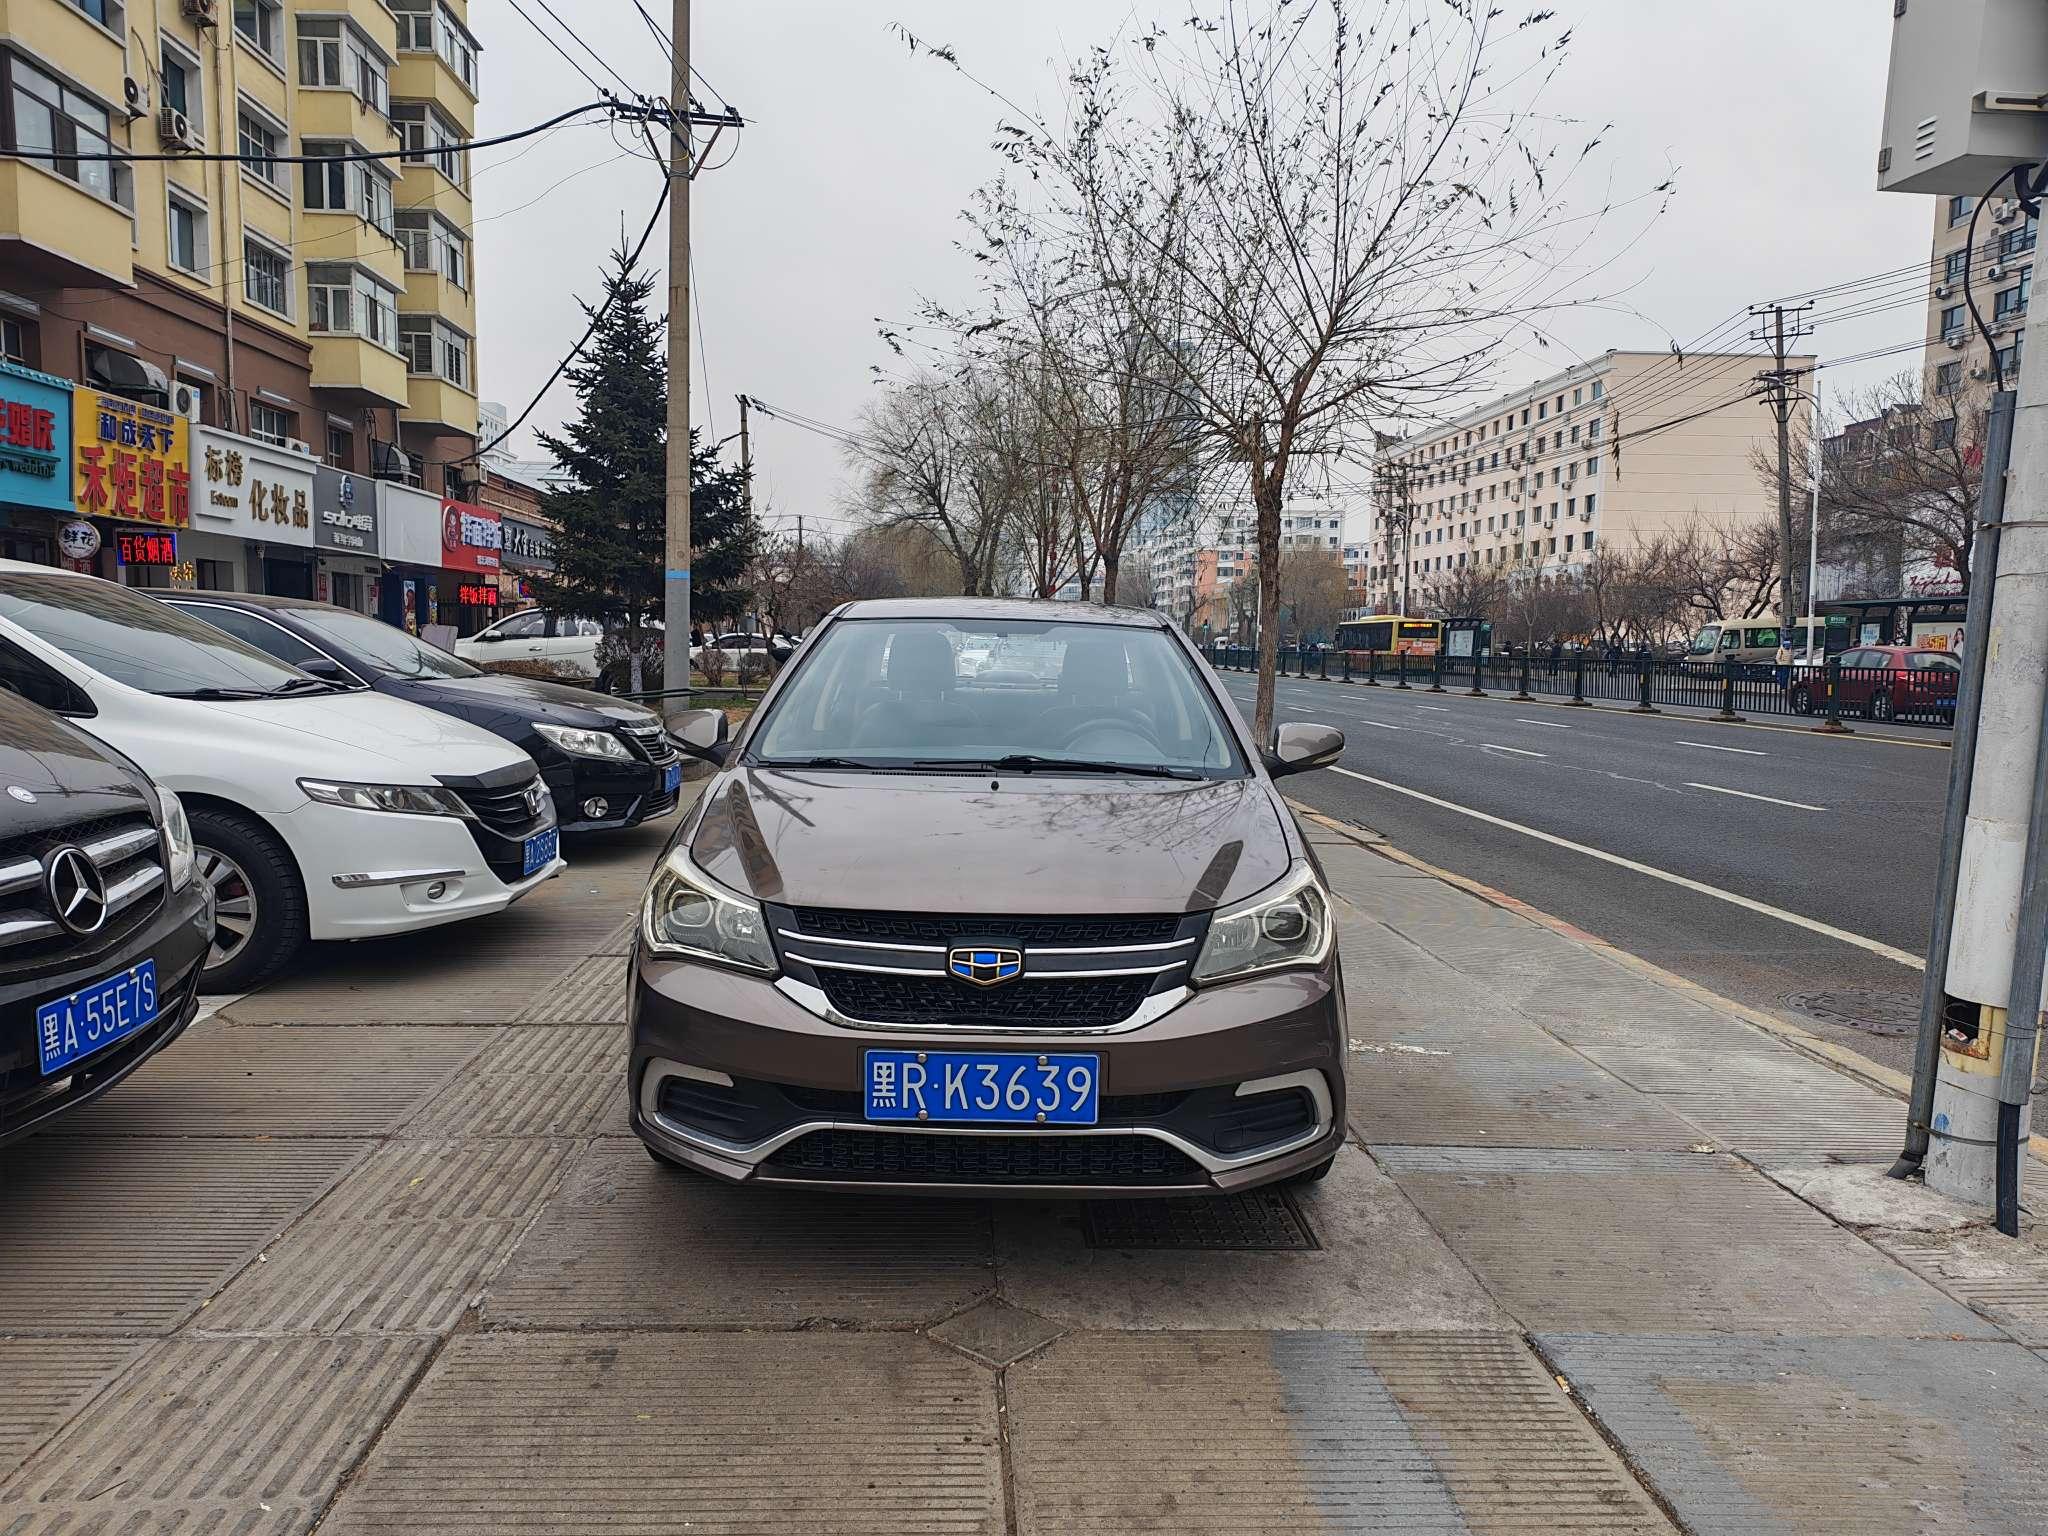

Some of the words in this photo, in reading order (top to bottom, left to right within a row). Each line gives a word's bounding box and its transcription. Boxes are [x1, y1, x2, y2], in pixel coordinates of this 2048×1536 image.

[0, 400, 55, 451] 婚庆
[249, 479, 309, 529] 化妆品
[63, 528, 95, 547] 鲜花
[120, 535, 174, 563] 百货烟酒
[872, 1061, 1092, 1112] 黑R·K3639
